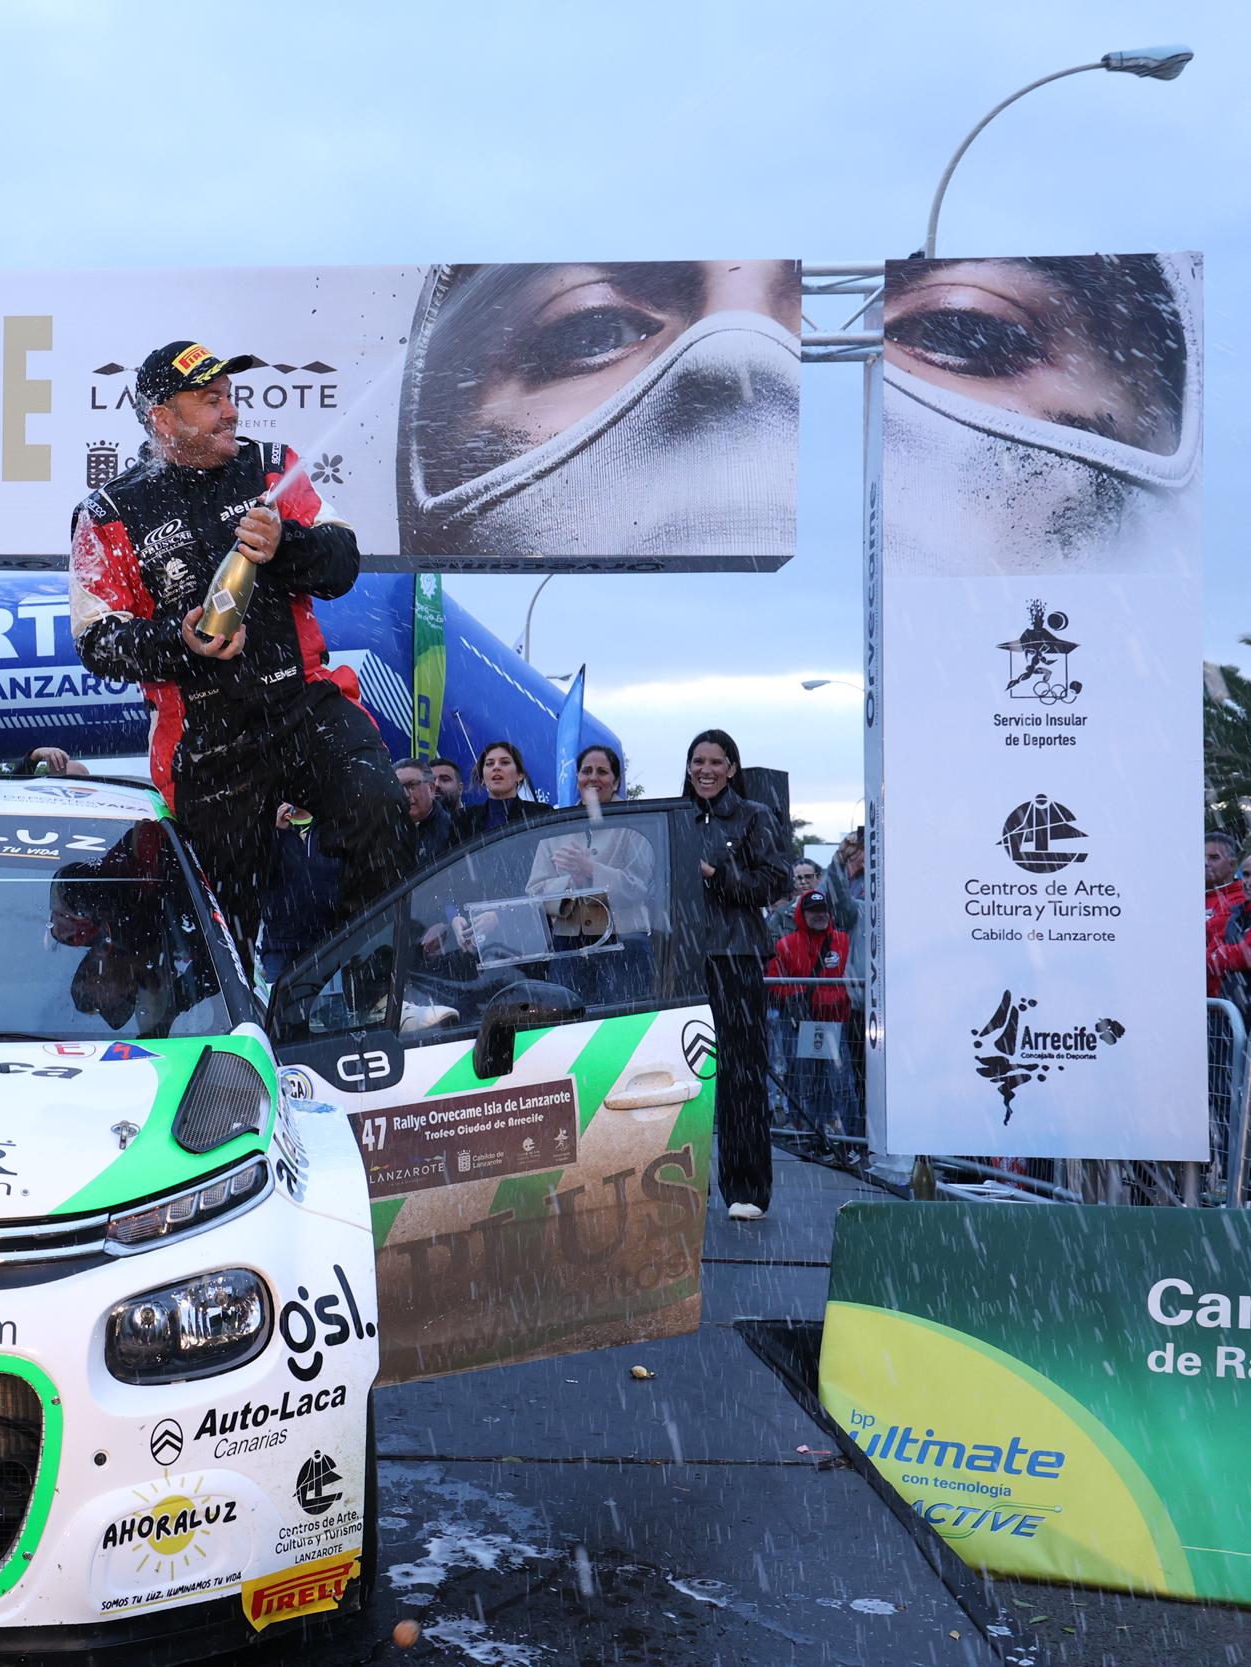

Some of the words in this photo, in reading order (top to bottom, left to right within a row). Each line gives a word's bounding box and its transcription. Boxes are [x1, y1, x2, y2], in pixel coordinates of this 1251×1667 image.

[993, 713, 1042, 727] Servicio
[1045, 713, 1088, 727] Insular
[1005, 733, 1019, 747] de
[1023, 733, 1077, 749] Deportes
[2, 845, 22, 854] TU
[25, 847, 61, 857] VIDA
[964, 879, 1038, 897] Centros
[1045, 879, 1068, 897] de
[1074, 879, 1121, 899] Arte,
[964, 900, 1033, 917] Cultura
[1034, 903, 1047, 922] y
[1048, 900, 1122, 918] Turismo
[971, 928, 1023, 942] Cabildo
[1027, 928, 1044, 942] de
[1048, 928, 1116, 943] Lanzarote
[1020, 1026, 1098, 1052] Arrecife
[336, 1049, 391, 1083] C3
[1056, 1052, 1064, 1060] de
[1065, 1052, 1097, 1061] Deportes
[361, 1116, 387, 1152] 47
[393, 1113, 427, 1132] Rallye
[428, 1105, 482, 1125] Orvecame
[484, 1100, 502, 1115] Isla
[504, 1097, 518, 1112] de
[519, 1090, 571, 1110] Lanzarote
[425, 1128, 455, 1141] Trofeo
[457, 1120, 492, 1136] Ciudad
[494, 1118, 506, 1129] de
[508, 1113, 544, 1127] Arrecife
[472, 1152, 495, 1163] Cabildo
[495, 1150, 505, 1159] de
[472, 1157, 503, 1169] Lanzarote
[369, 1161, 445, 1185] LANZAROTE
[1148, 1343, 1203, 1378] de
[193, 1384, 348, 1442] Auto-Laca
[851, 1408, 875, 1431] bp
[213, 1426, 288, 1460] Canarias
[849, 1425, 1066, 1480] ultimate
[901, 1473, 930, 1487] con
[932, 1474, 1012, 1498] tecnología
[102, 1501, 238, 1550] AHORALUZ
[278, 1521, 320, 1540] Centros
[322, 1516, 335, 1528] de
[324, 1521, 363, 1541] Turismo
[910, 1499, 1047, 1539] ACTIVE
[294, 1543, 343, 1564] LANZAROTE
[101, 1597, 128, 1611] SOMOS
[131, 1595, 143, 1605] TU
[166, 1579, 211, 1598] ILUMINAMOS
[213, 1576, 223, 1586] TU
[225, 1571, 242, 1583] VIDA
